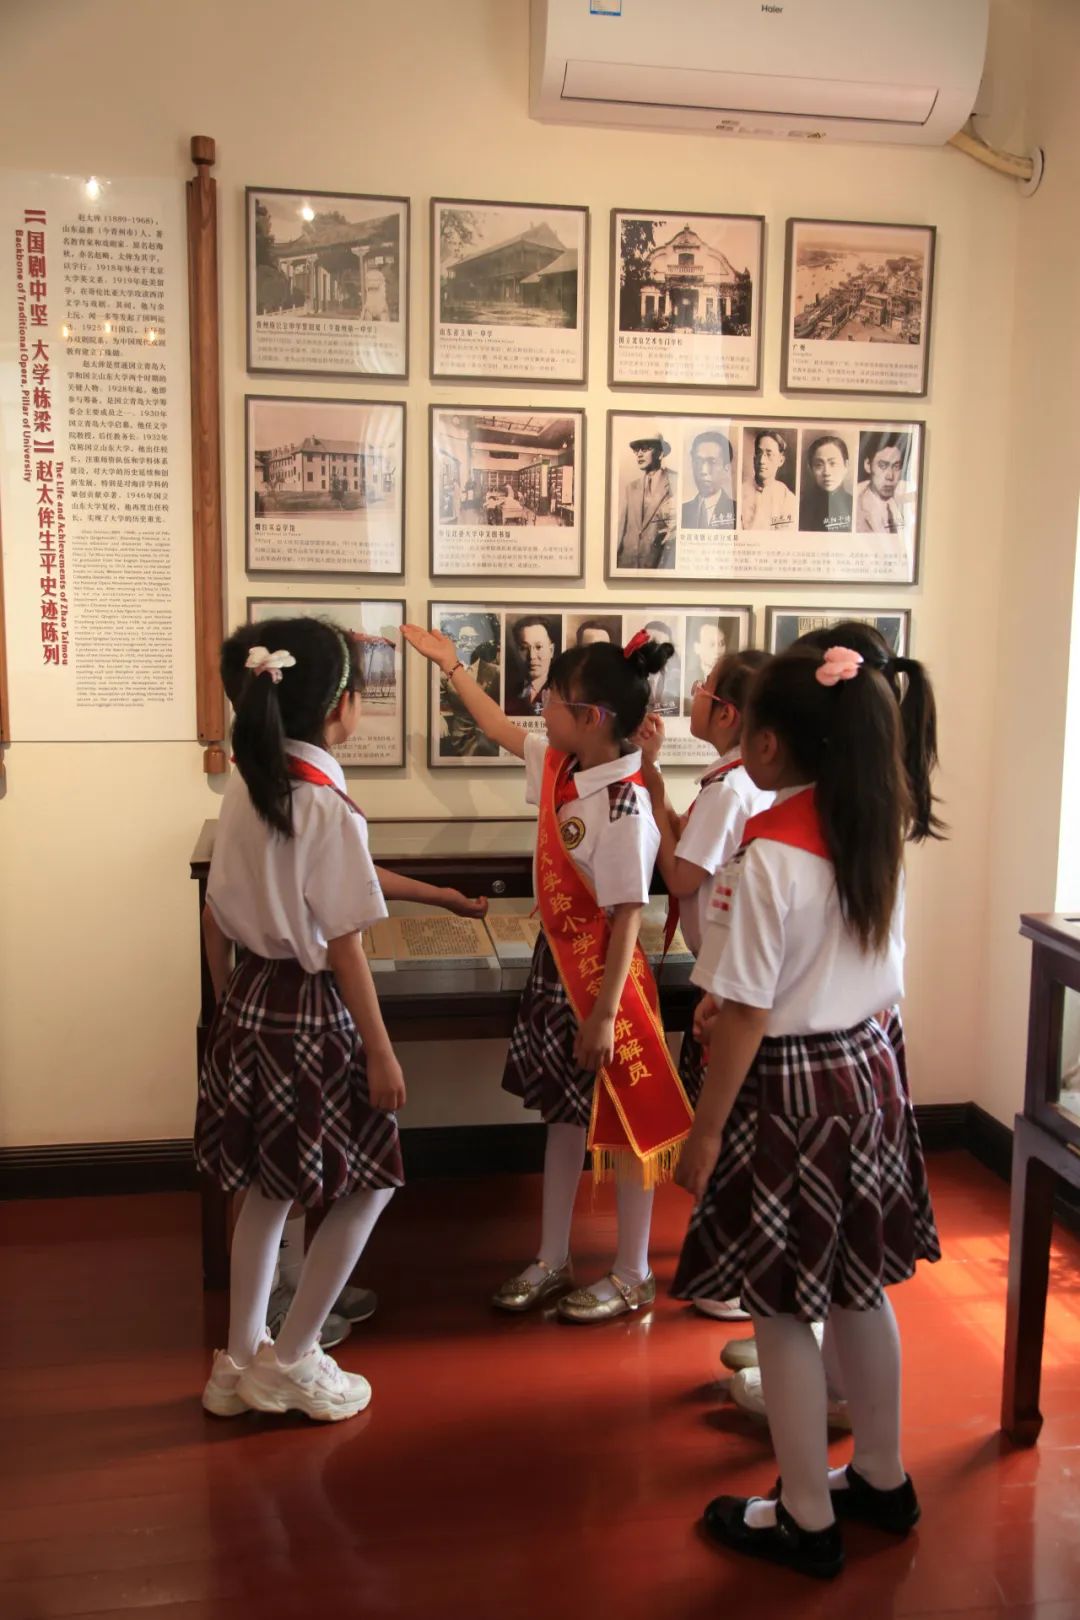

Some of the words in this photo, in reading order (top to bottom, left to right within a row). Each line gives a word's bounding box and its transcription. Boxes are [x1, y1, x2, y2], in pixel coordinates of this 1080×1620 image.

[761, 4, 784, 14] Haier
[15, 229, 25, 280] Backbone
[17, 282, 27, 293] of
[17, 294, 29, 351] Traditional
[18, 353, 29, 387] Opera,
[21, 390, 31, 416] Pillar
[22, 418, 31, 429] of
[22, 430, 33, 482] University
[56, 461, 64, 479] The
[56, 481, 65, 499] Life
[57, 502, 66, 520] and
[57, 522, 66, 589] Achievements
[60, 591, 69, 601] of
[60, 604, 69, 628] Zhao
[61, 630, 70, 665] Taimou
